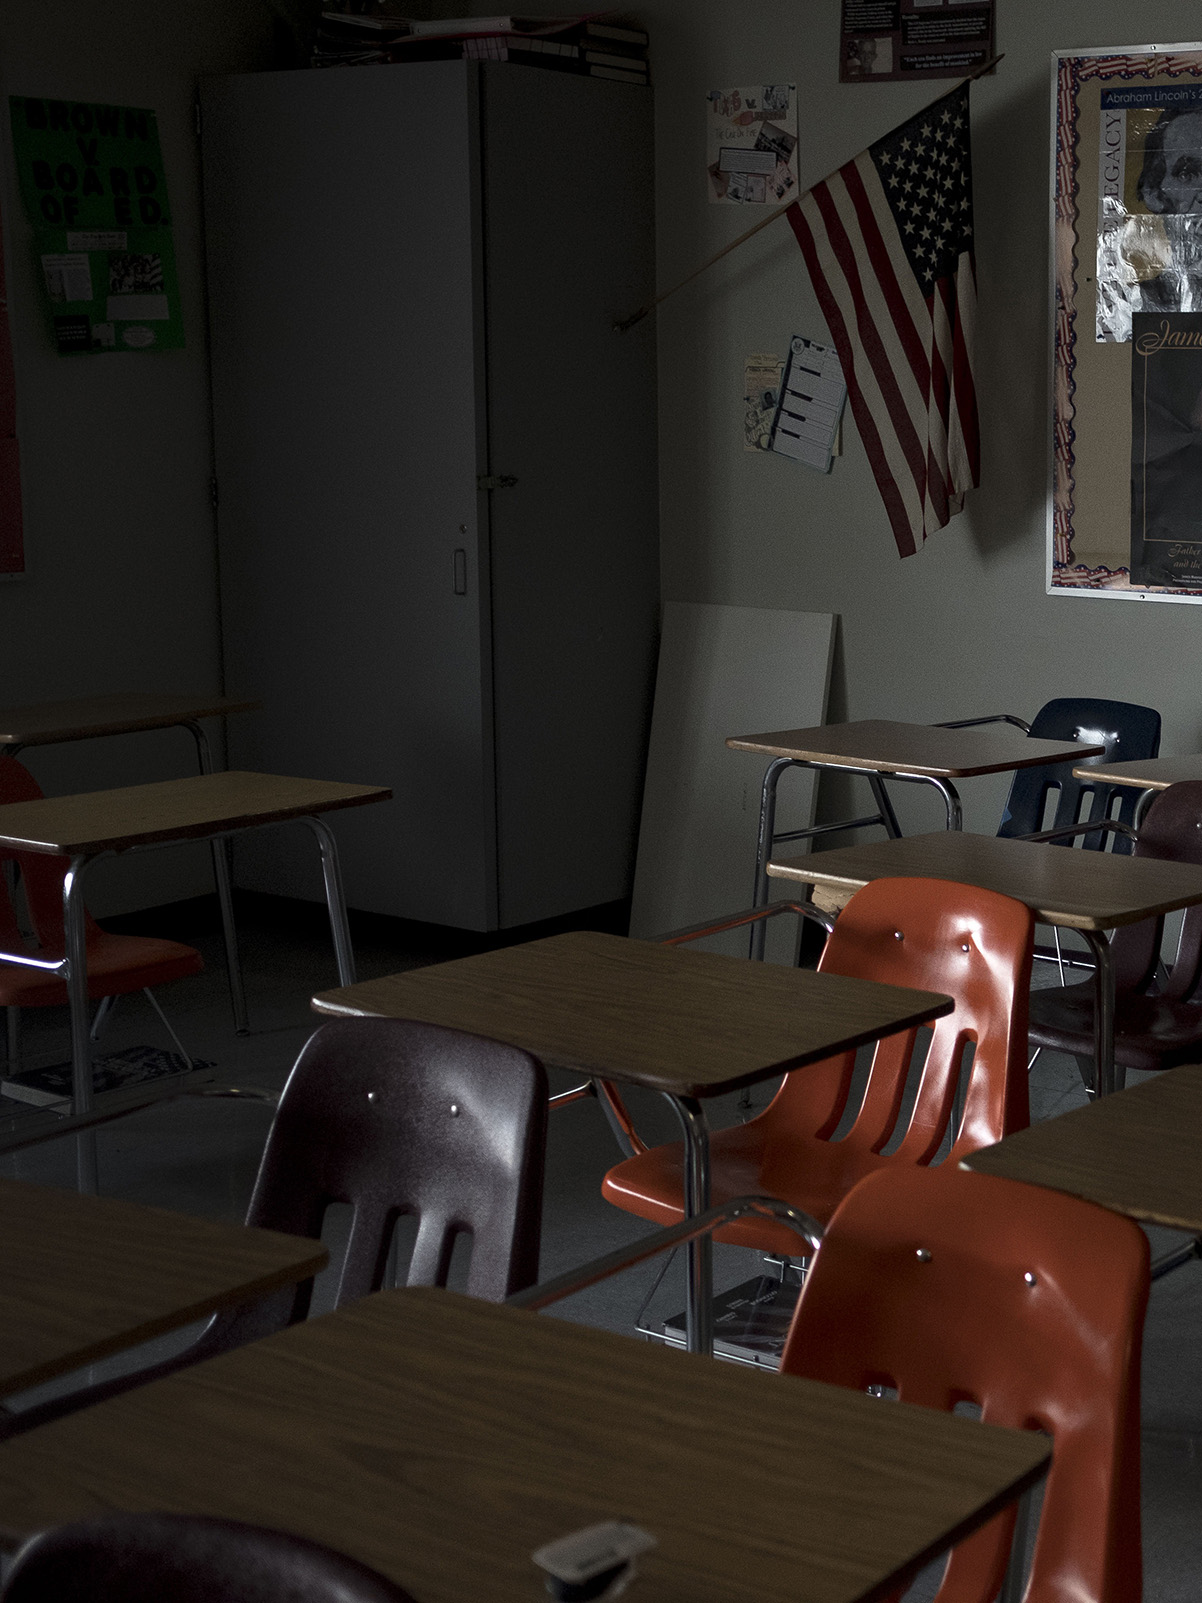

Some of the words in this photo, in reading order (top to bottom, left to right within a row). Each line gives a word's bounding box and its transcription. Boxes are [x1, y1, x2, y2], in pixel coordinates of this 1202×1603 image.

[1106, 92, 1151, 104] Abraham
[1154, 90, 1197, 101] Lincoln's
[24, 98, 148, 141] BROWN
[76, 136, 99, 166] V.
[32, 160, 157, 197] BOARD
[41, 194, 79, 225] OF
[115, 196, 169, 226] ED.
[1168, 543, 1201, 558] Father
[1173, 559, 1189, 568] and
[1189, 560, 1201, 569] the
